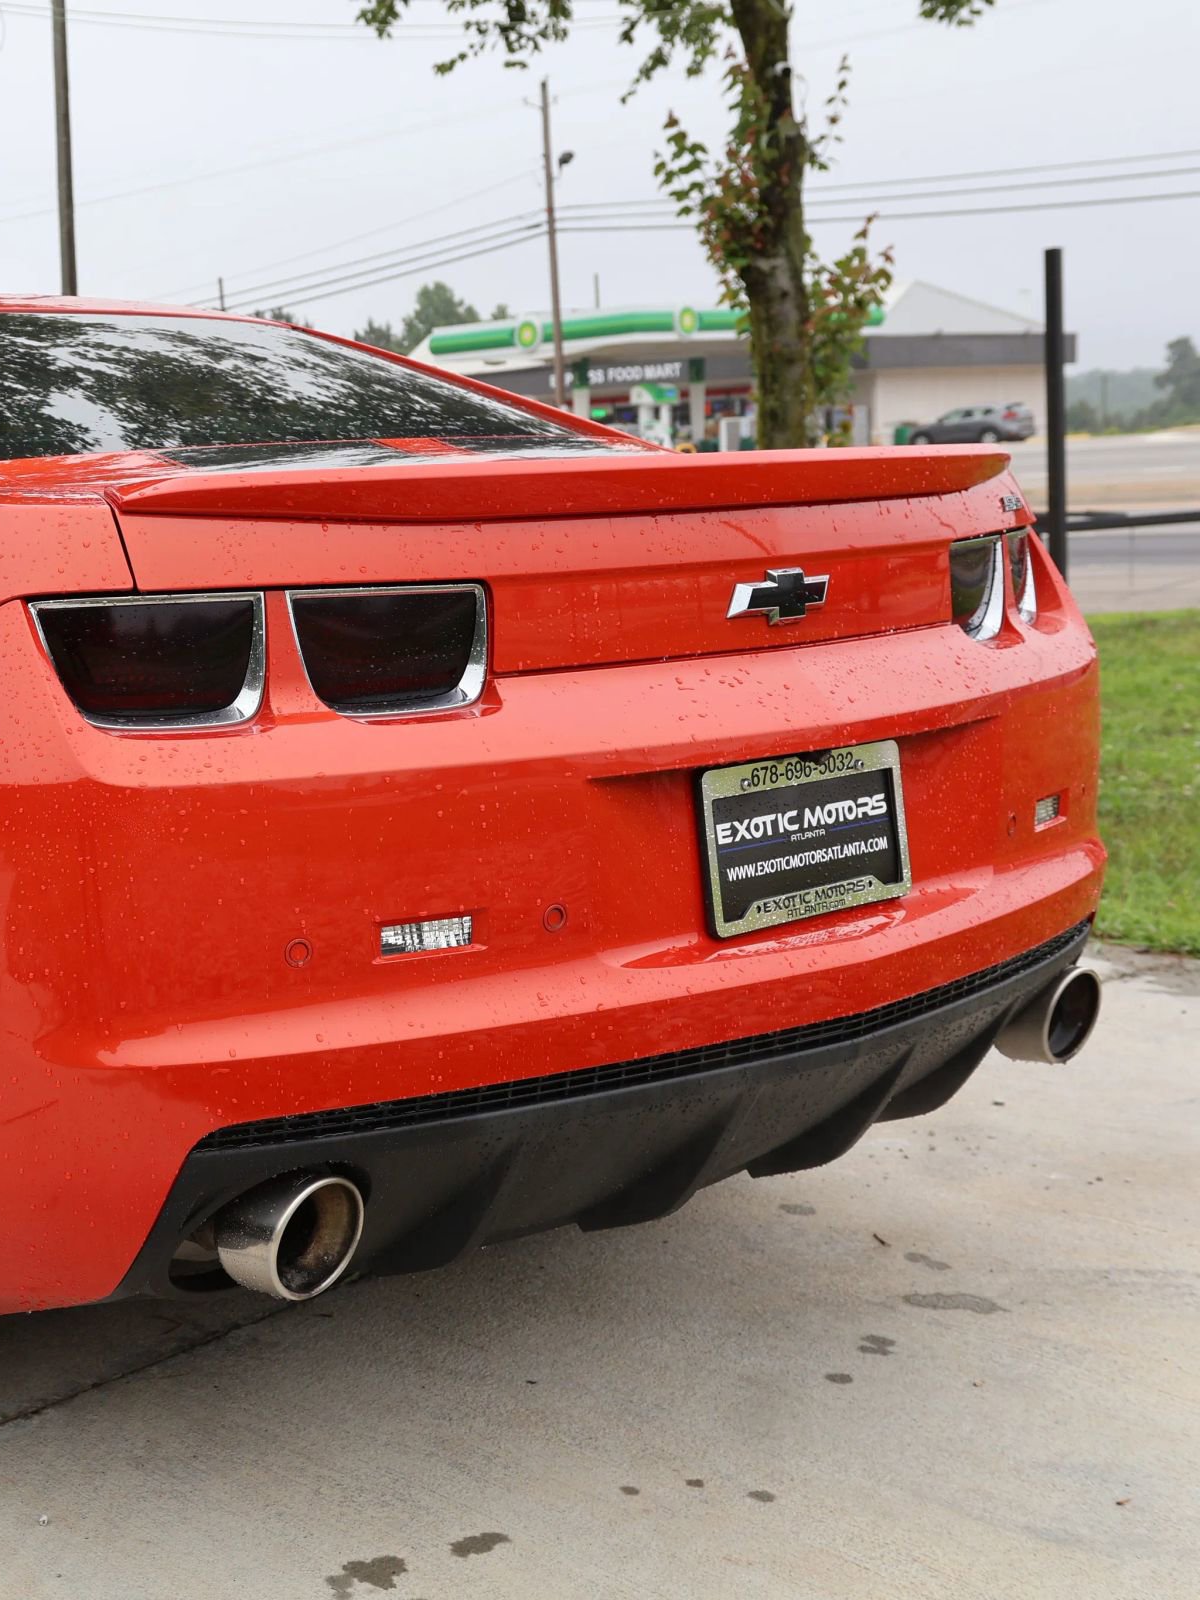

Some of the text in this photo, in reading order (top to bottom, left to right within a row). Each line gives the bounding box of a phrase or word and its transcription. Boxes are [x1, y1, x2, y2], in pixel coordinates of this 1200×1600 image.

[548, 362, 681, 389] EPSS FOOD MART
[751, 751, 854, 787] 678-696-5032
[715, 793, 888, 845] EXOTIC MOTORS
[790, 828, 826, 842] ATLANTA
[726, 836, 888, 882] WWW.EXOTICMOTORSATLANTA.COM
[763, 879, 866, 914] EXOTIC MOTORS
